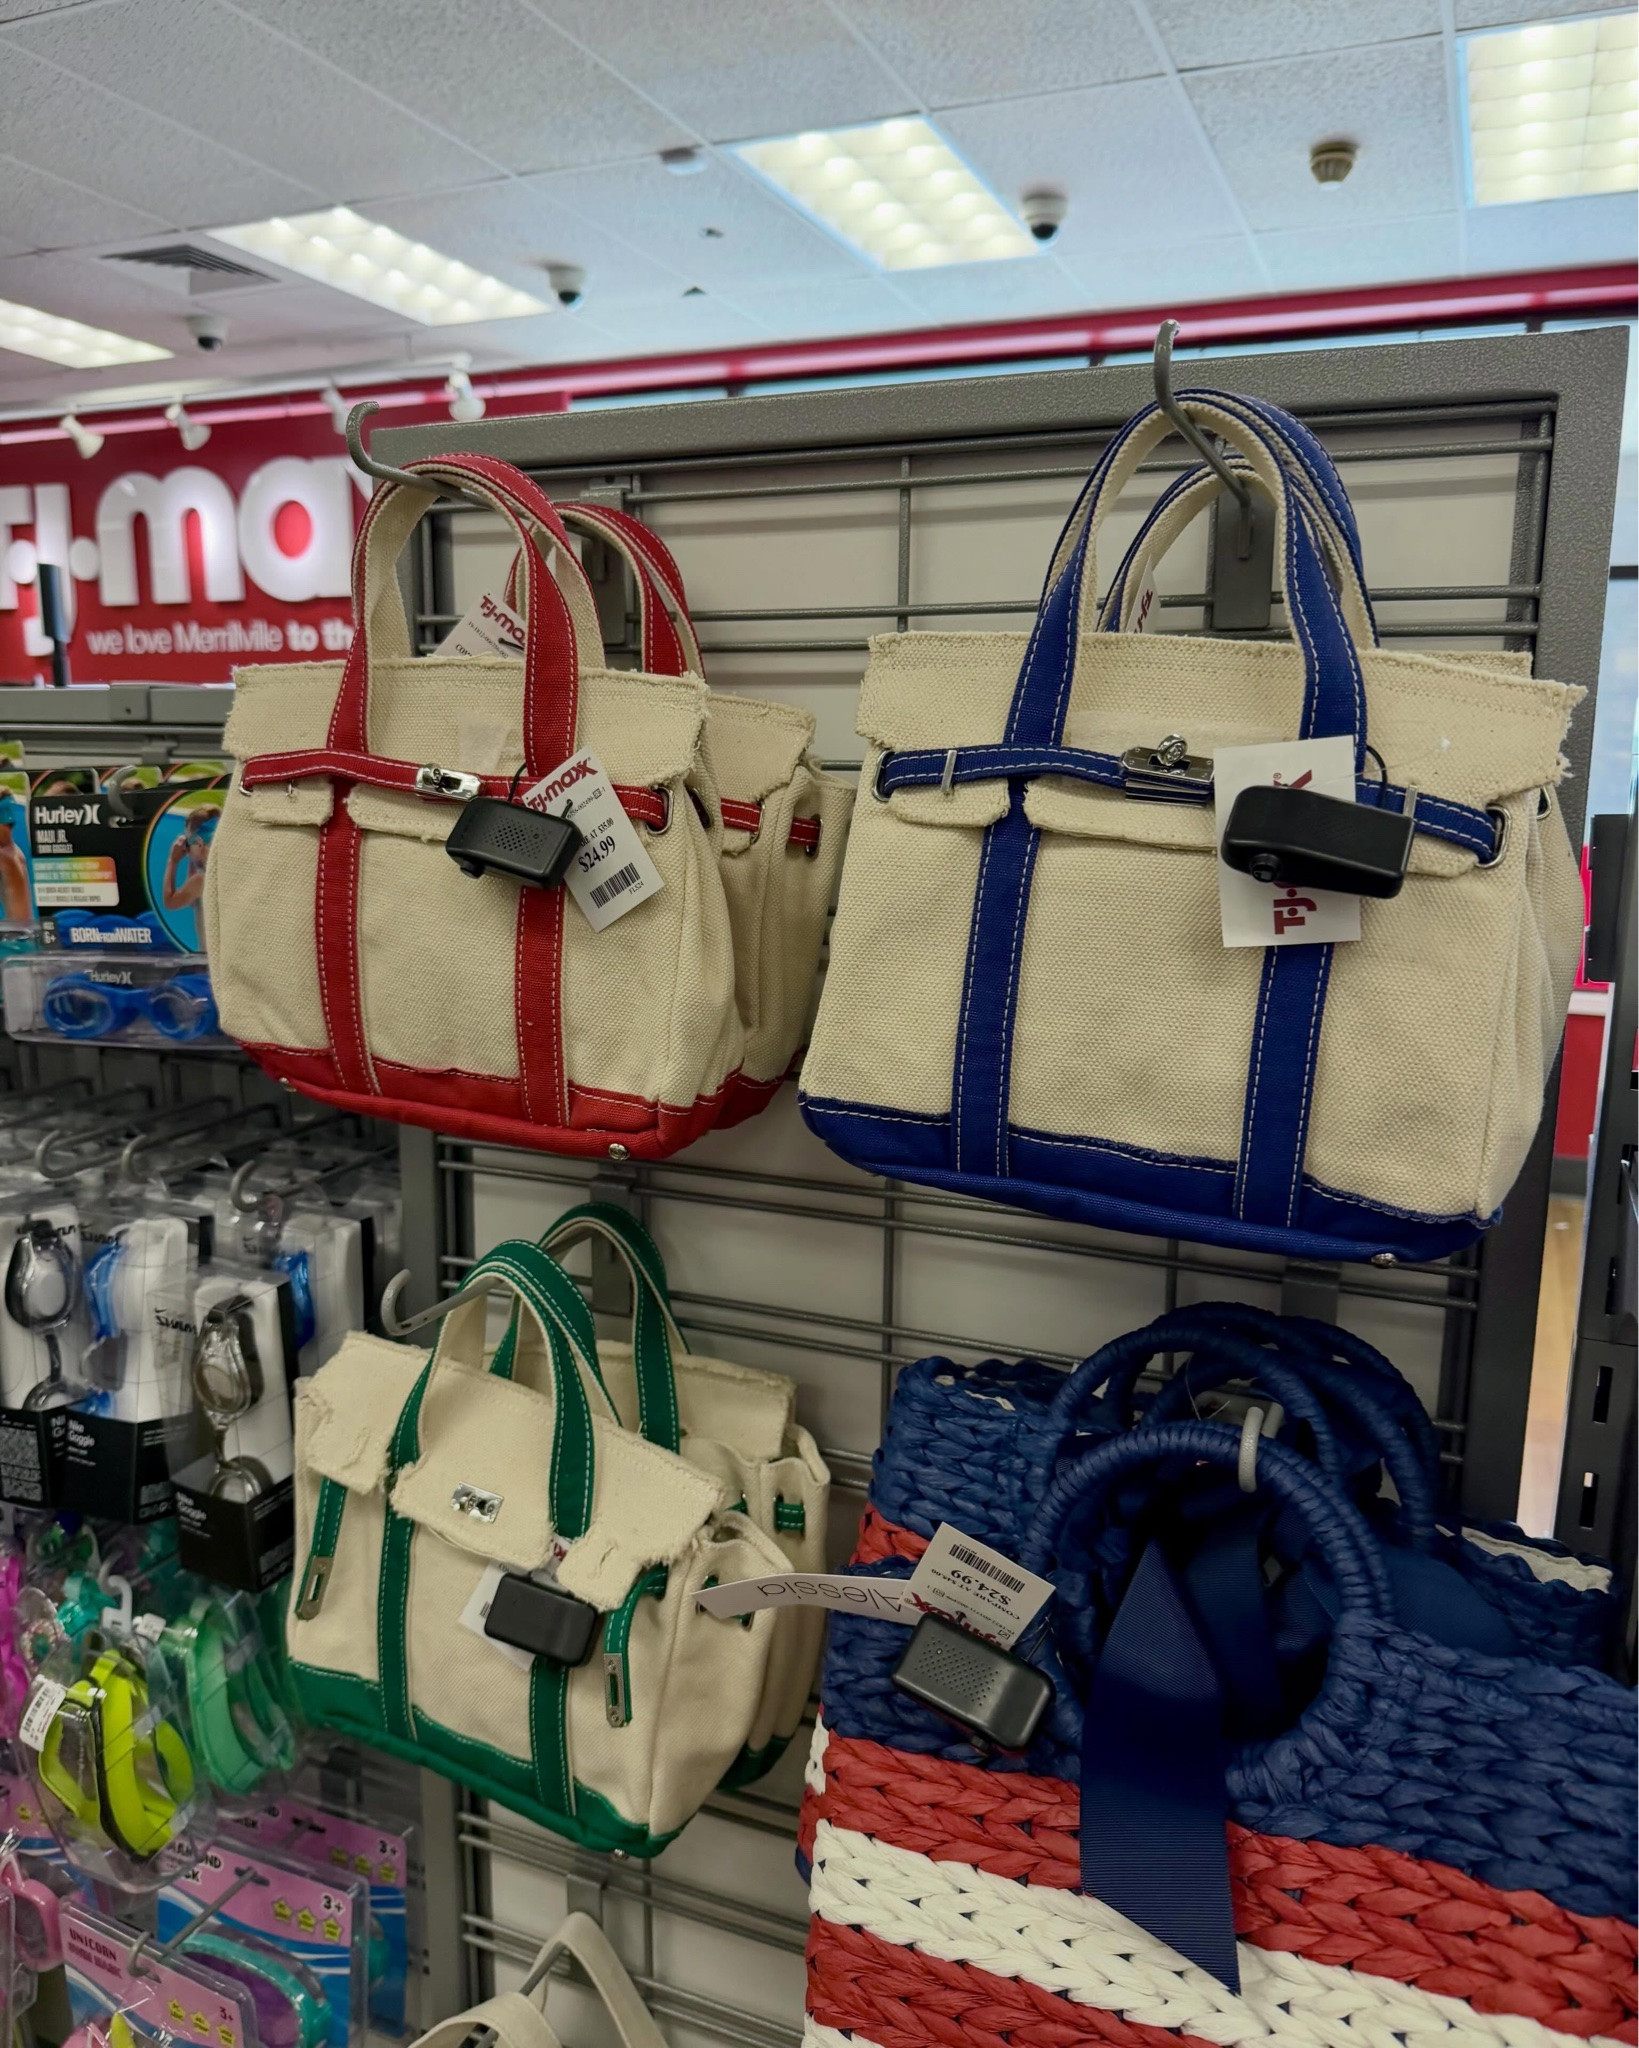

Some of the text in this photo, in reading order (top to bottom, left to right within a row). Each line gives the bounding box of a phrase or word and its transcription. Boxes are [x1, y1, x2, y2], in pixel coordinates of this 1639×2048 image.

[86, 630, 123, 655] we
[123, 621, 173, 654] love
[286, 619, 320, 652] to
[35, 805, 84, 825] Hurley
[578, 835, 616, 873] $24.99
[757, 1581, 902, 1612] Alessia
[950, 1569, 1011, 1606] $24.99
[973, 1592, 1020, 1620] COMPARE
[323, 1894, 343, 1913] 3+
[69, 1928, 117, 1961] UNICORN
